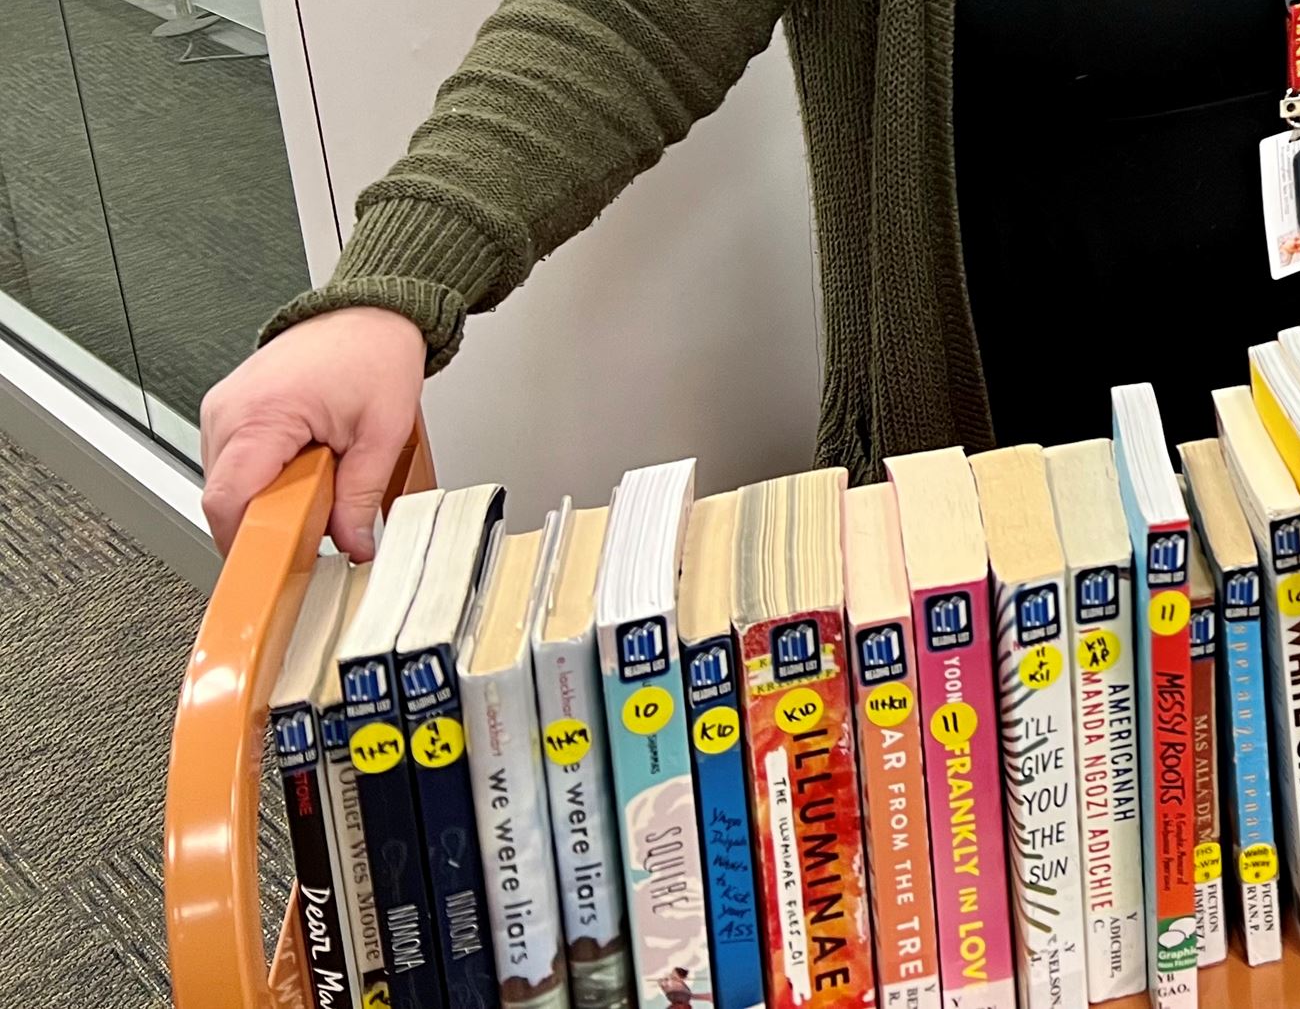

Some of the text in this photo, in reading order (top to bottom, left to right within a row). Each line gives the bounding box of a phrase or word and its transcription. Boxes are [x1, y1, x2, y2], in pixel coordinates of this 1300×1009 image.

[1161, 604, 1175, 621] 11
[634, 703, 659, 718] 10
[943, 656, 963, 704] YOON
[942, 712, 959, 733] 11
[1025, 715, 1058, 740] I'LL
[1108, 684, 1136, 822] AMERICANAH
[1156, 671, 1187, 806] MESSY ROOTS
[1020, 747, 1065, 779] GIVE
[773, 778, 797, 890] THE ILLUMINAE
[1022, 783, 1068, 816] YOU
[1084, 755, 1113, 912] NGOZI ADICHIE
[1197, 802, 1211, 826] DE
[339, 768, 381, 962] Other Wes Moore
[489, 768, 533, 965] we were liars
[565, 781, 602, 926] were liars
[643, 826, 690, 915] SQUIRE
[792, 728, 850, 992] ILLUMINAE
[881, 729, 924, 978] AR FROM THE TRE
[944, 742, 988, 982] FRANKLY IN LOV
[1028, 821, 1066, 851] THE
[1029, 856, 1068, 886] SUN
[387, 904, 426, 974] NIMONA
[445, 890, 483, 960] NIMONA
[719, 922, 754, 939] ASS
[1207, 884, 1218, 933] FICTION
[1262, 882, 1274, 931] FICTION
[301, 882, 345, 1009] Dear Ma
